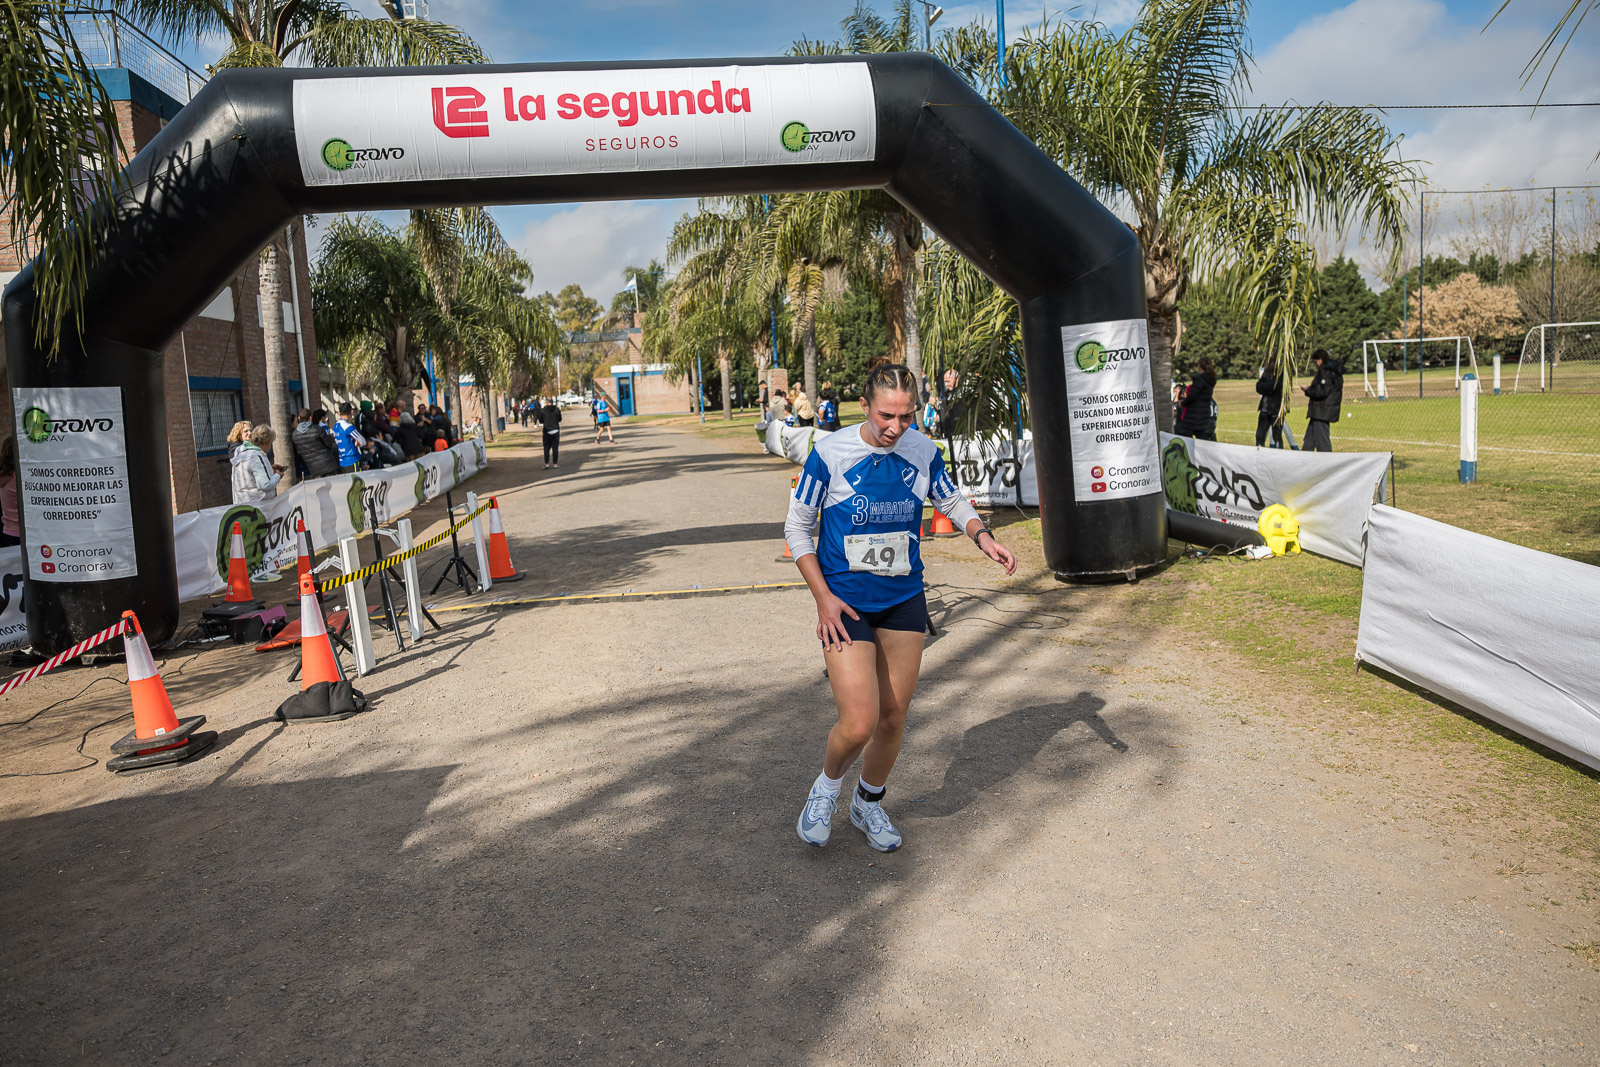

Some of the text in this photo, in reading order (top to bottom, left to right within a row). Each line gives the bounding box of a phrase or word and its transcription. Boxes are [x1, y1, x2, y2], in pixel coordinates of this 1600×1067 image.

[503, 80, 752, 127] la segunda
[802, 130, 856, 143] CRONO
[585, 135, 679, 152] SEGUROS
[345, 147, 404, 162] CRONO
[1098, 346, 1146, 363] CRONO
[1098, 364, 1118, 372] RAV
[1079, 390, 1148, 406] "SOMOS CORREDORES
[1073, 402, 1153, 419] BUSCANDO MEJORAR LAS
[43, 418, 114, 433] CRONO
[1081, 416, 1150, 431] EXPERIENCIAS DE LOS
[42, 434, 66, 442] RAV
[1095, 430, 1143, 443] CORREDORES"
[28, 466, 115, 478] "SOMOS CORREDORES
[1108, 464, 1150, 477] Cronorav
[24, 479, 124, 492] BUSCANDO MEJORAR LAS
[1109, 478, 1151, 490] Cronorav
[31, 494, 117, 506] EXPERIENCIAS DE LOS
[43, 509, 102, 521] CORREDORES"
[851, 494, 915, 526] 3 MARATÓN
[56, 547, 113, 558] Cronorav
[861, 546, 896, 568] 49
[58, 562, 114, 573] Cronorav
